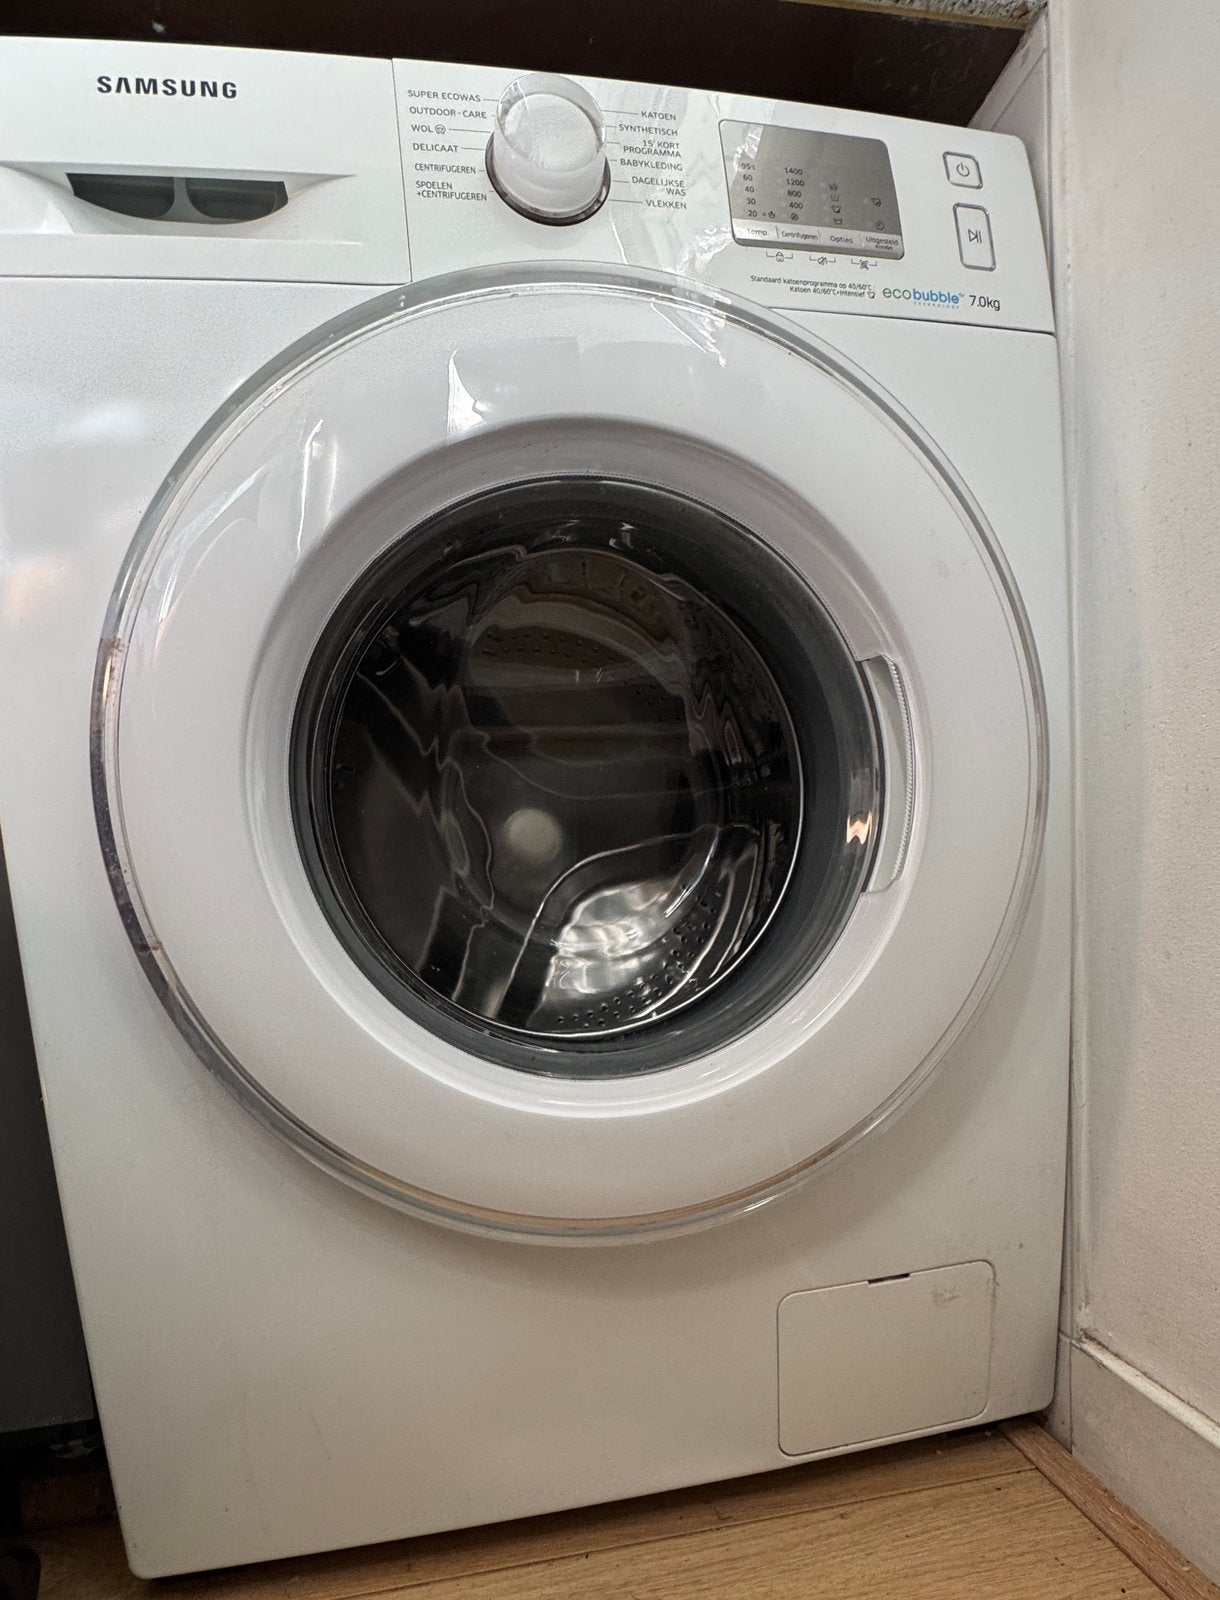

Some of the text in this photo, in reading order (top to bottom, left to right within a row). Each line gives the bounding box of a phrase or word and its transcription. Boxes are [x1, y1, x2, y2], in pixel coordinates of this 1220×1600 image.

[97, 75, 237, 99] SAMSUNG
[407, 89, 481, 102] SUPER ECOWAS
[641, 110, 677, 121] KATOEN
[411, 124, 434, 133] WOL
[618, 123, 678, 136] SYNTHETISCH
[412, 142, 459, 153] DELICAAT
[657, 141, 680, 150] KORT
[623, 145, 682, 158] PROGRAMMA
[414, 163, 476, 175] CENTRIFUGEREN
[620, 158, 683, 171] BABYKLEDING
[784, 166, 803, 176] 1400
[415, 180, 453, 190] SPOELEN
[631, 176, 685, 188] DAGELIJKSE
[786, 178, 805, 187] 1200
[665, 187, 686, 197] WAS
[744, 185, 755, 193] 40
[787, 189, 802, 198] 800
[645, 199, 687, 210] VLEKKEN
[746, 197, 757, 205] 30
[788, 201, 804, 210] 400
[747, 209, 758, 218] 20
[750, 275, 782, 284] Standaard
[782, 277, 838, 289] katoenprogramma
[789, 286, 812, 294] Katoen
[968, 294, 1001, 312] 7.0kg
